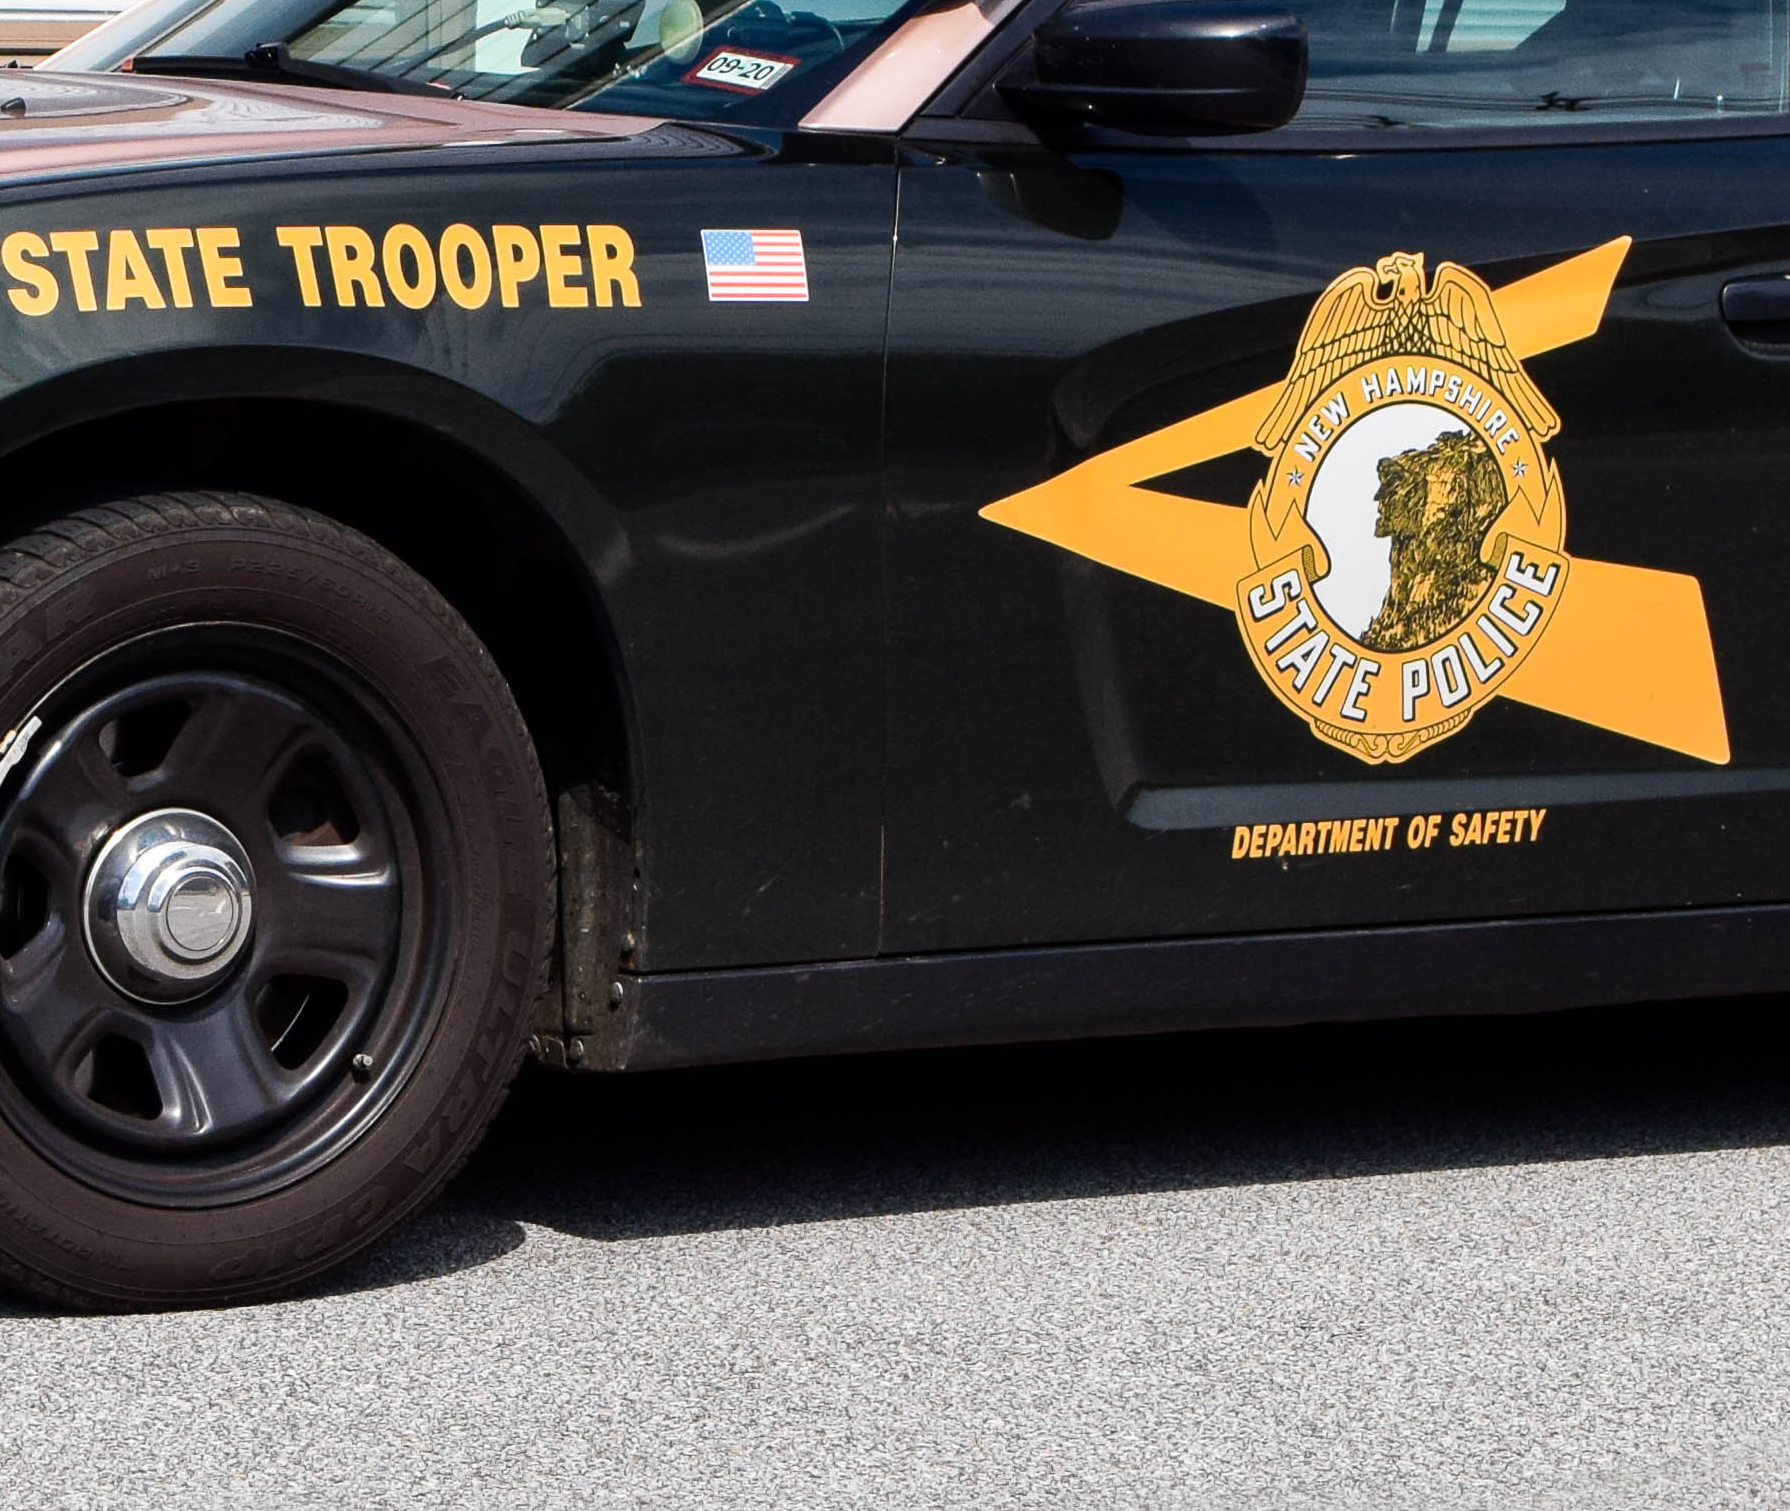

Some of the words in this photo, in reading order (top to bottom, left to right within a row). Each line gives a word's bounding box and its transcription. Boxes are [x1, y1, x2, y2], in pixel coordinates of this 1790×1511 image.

[707, 57, 775, 81] 09-20
[1, 227, 253, 317] STATE
[277, 222, 642, 310] TROOPER
[1293, 391, 1351, 464] NEW
[1361, 366, 1521, 456] HAMPSHIRE
[1248, 570, 1379, 721] STATE
[1403, 552, 1559, 721] POLICE
[1232, 818, 1396, 858] DEPARTMENT
[1408, 816, 1441, 850] OF
[1449, 808, 1546, 846] SAFETY
[405, 930, 531, 1174] ULTRA
[210, 1184, 391, 1276] GRIP
